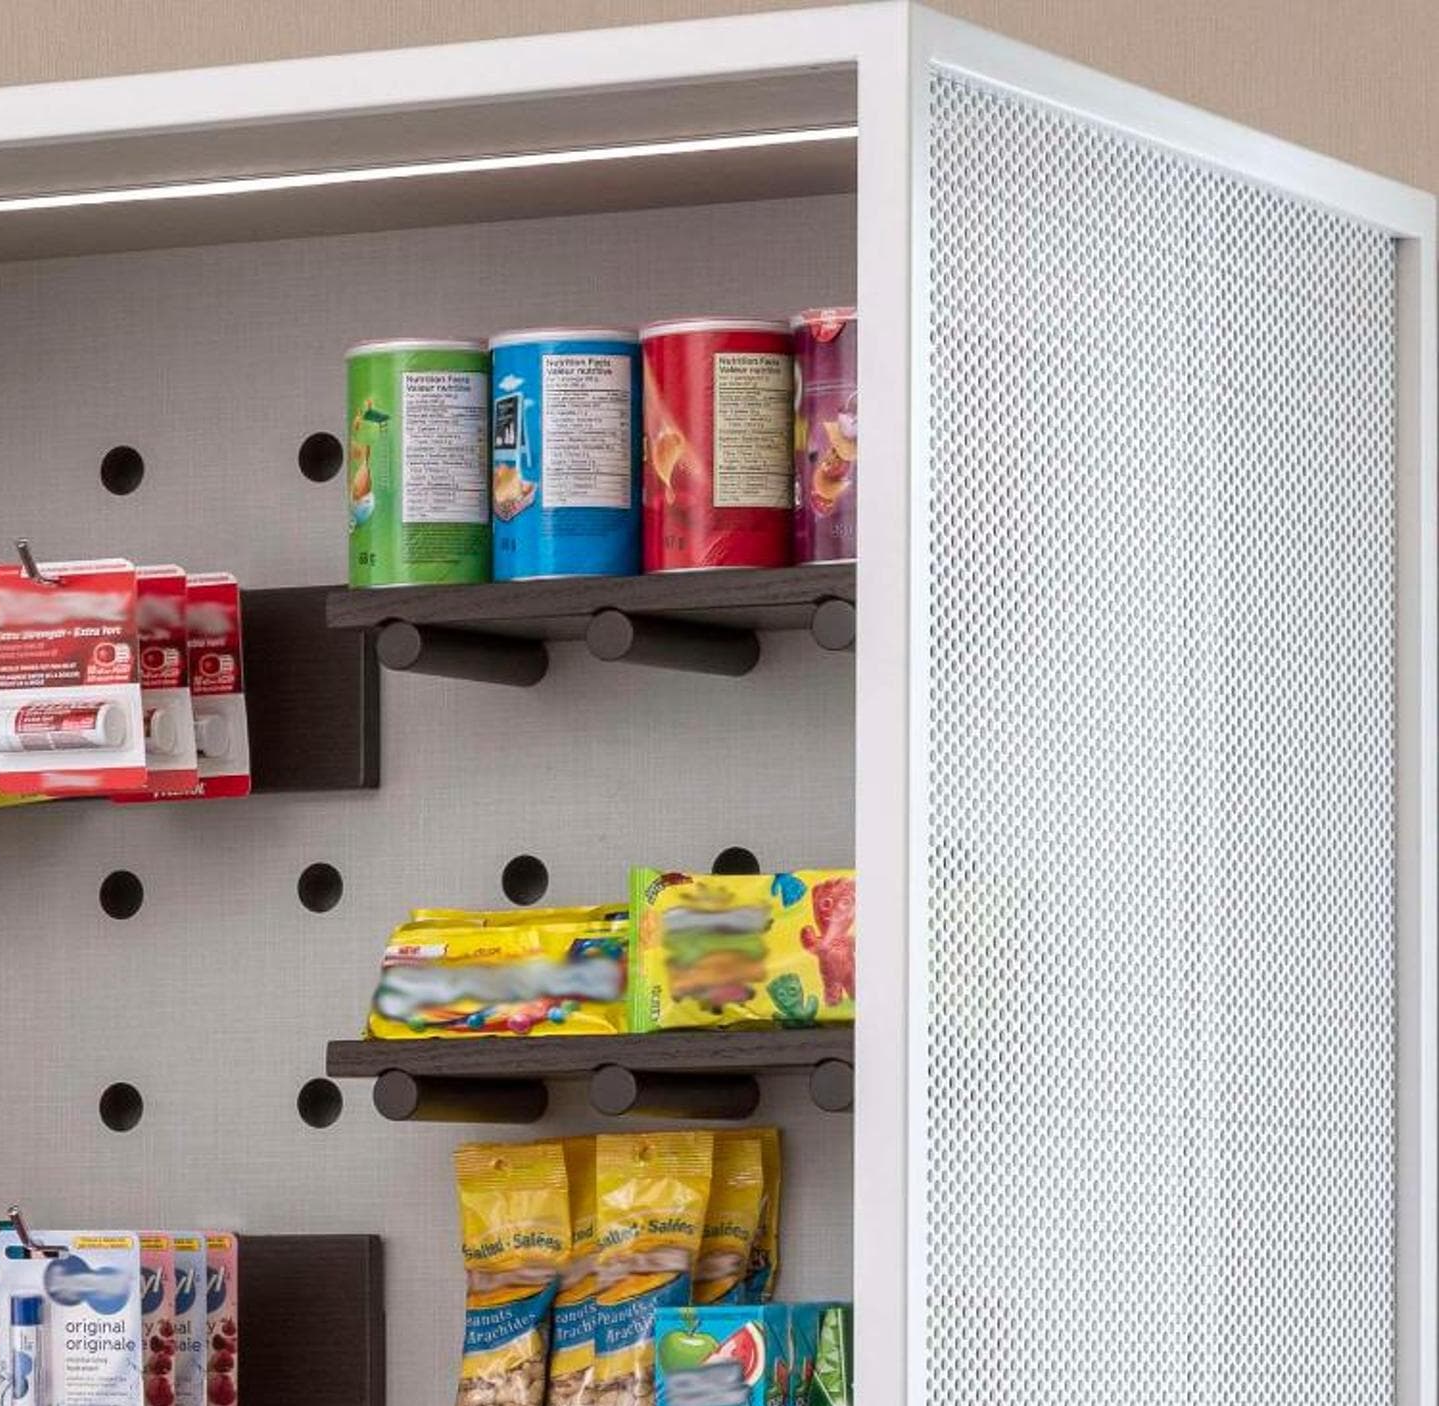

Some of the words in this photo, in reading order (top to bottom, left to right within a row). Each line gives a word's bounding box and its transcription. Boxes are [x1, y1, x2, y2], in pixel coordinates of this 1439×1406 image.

[513, 1233, 561, 1251] Salées
[465, 1310, 513, 1328] eanuts
[555, 1304, 598, 1324] eanuts
[65, 1318, 126, 1336] original
[65, 1335, 137, 1354] originale
